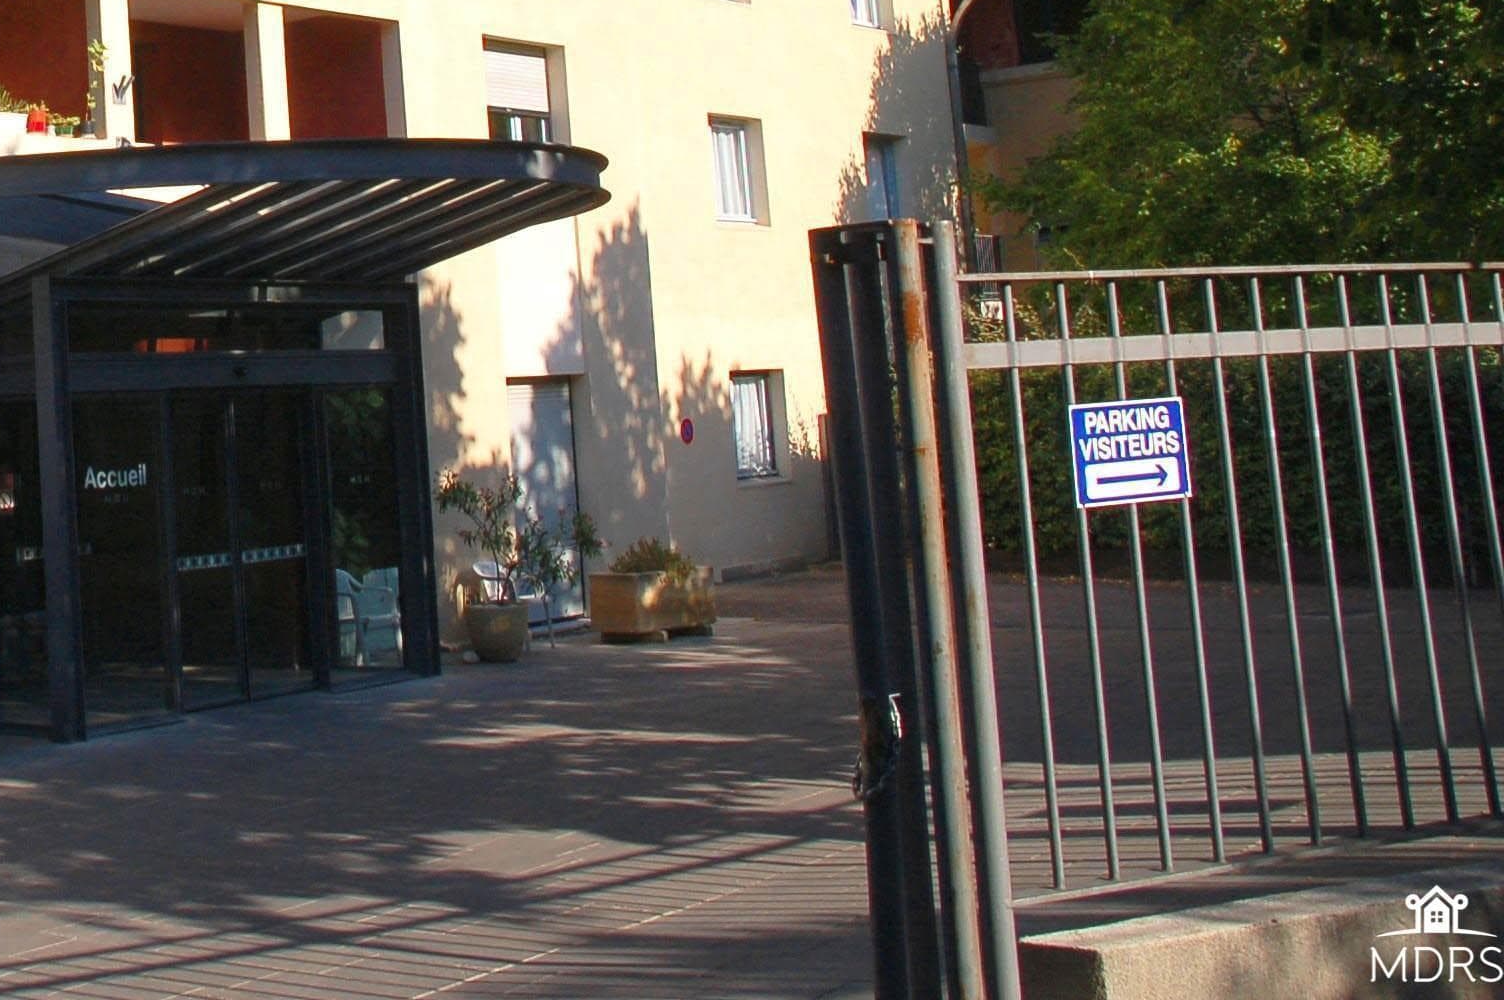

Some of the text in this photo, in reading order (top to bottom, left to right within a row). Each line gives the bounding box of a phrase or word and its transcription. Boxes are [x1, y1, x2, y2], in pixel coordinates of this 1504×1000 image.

[1084, 405, 1170, 435] PARKING
[1079, 430, 1180, 461] VISITEURS
[84, 463, 147, 489] Accueil
